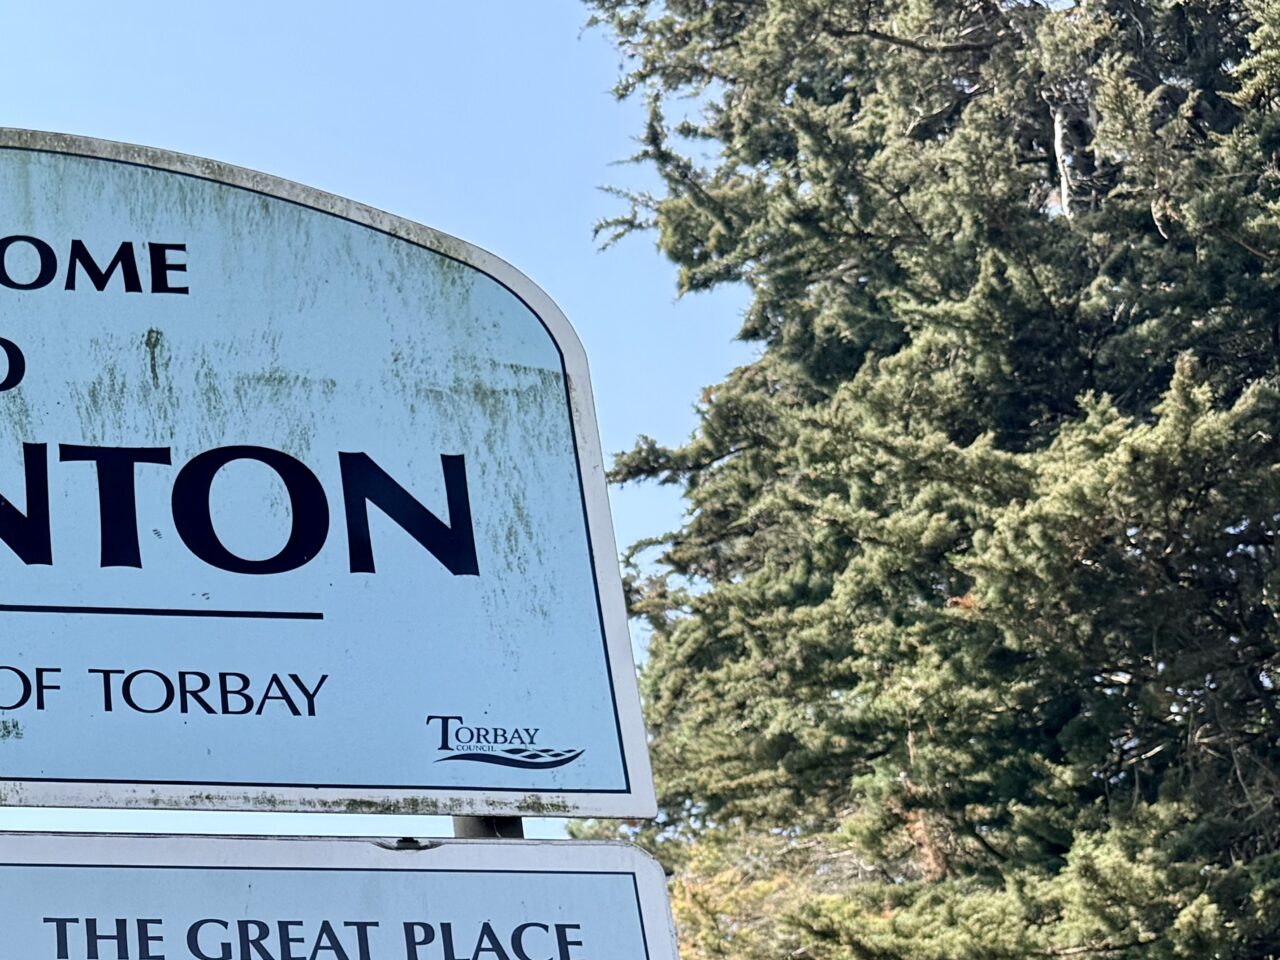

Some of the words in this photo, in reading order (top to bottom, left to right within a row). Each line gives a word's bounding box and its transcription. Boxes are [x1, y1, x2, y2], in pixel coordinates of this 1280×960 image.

[89, 669, 329, 717] TORBAY
[426, 716, 539, 751] TORBAY
[456, 744, 497, 752] COUNCIL
[43, 918, 165, 960] THE
